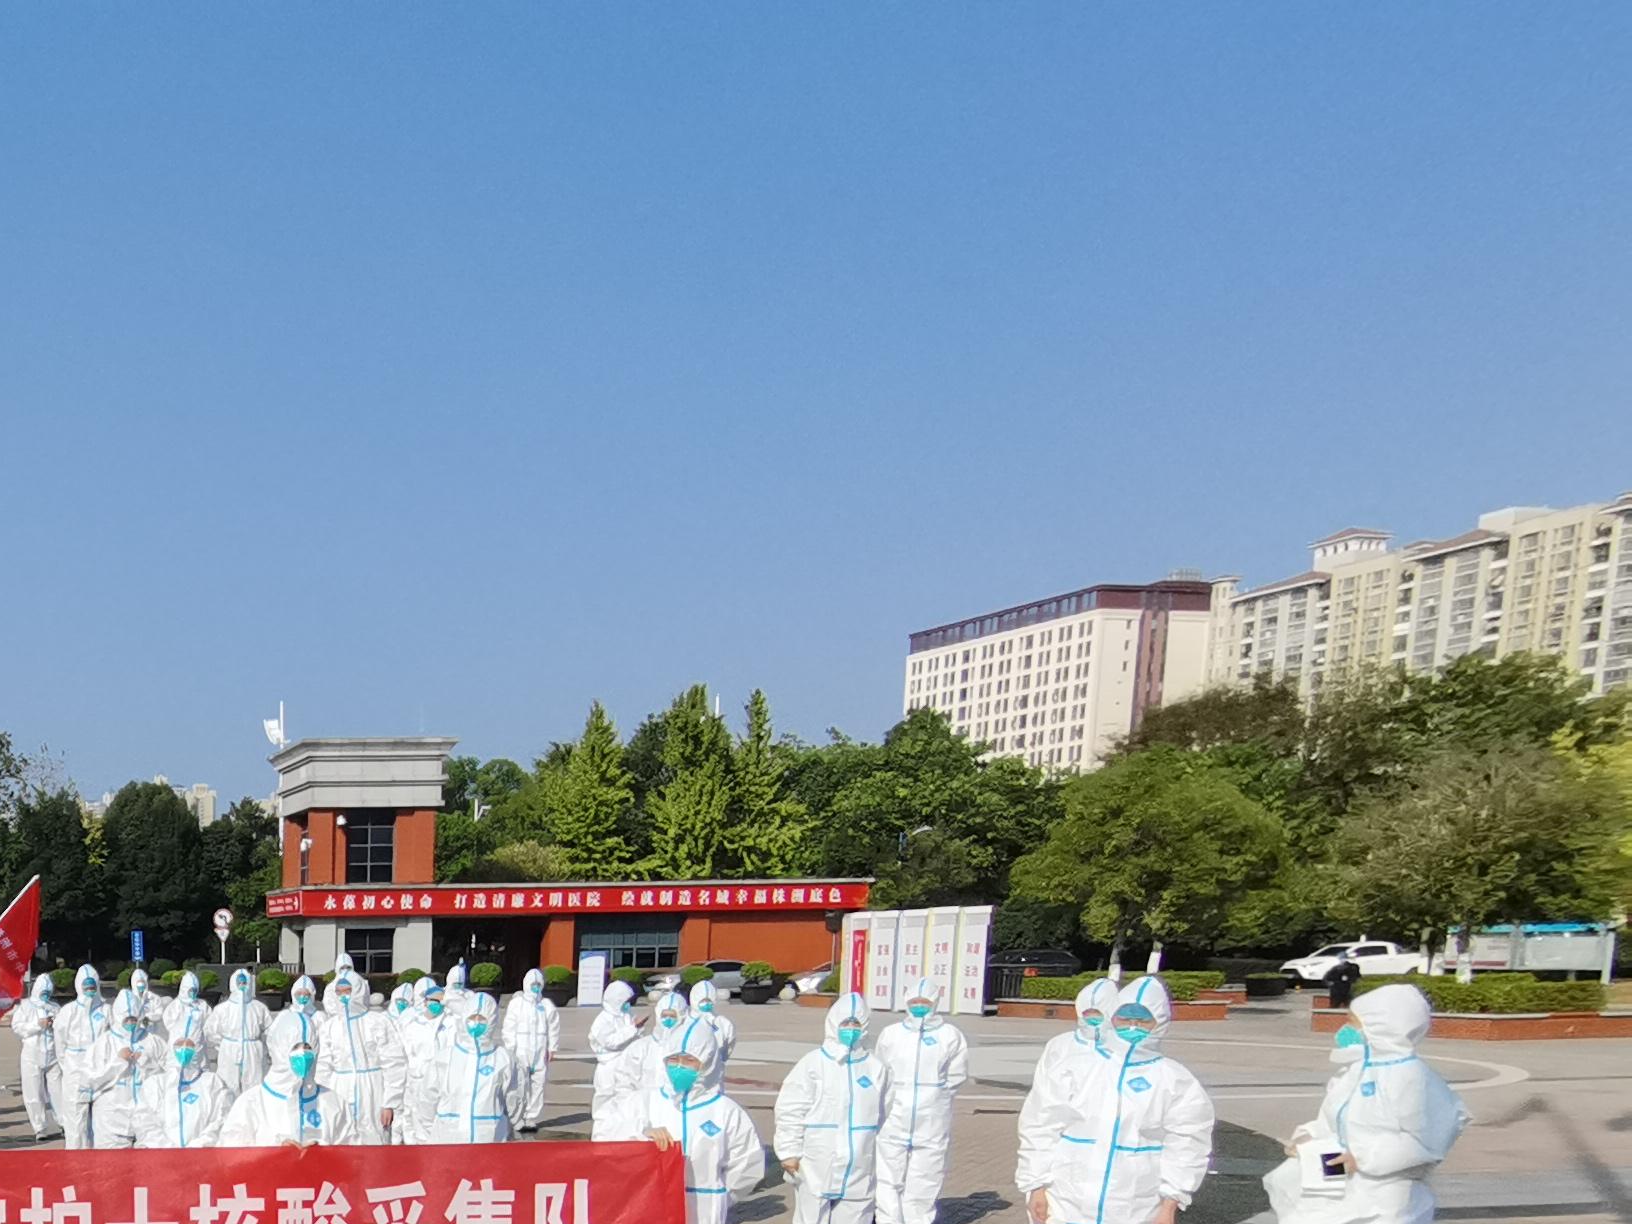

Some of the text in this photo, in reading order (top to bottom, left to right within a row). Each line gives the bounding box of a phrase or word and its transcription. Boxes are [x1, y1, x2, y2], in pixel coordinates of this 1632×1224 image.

[453, 891, 601, 910] 打造清廉文明医院
